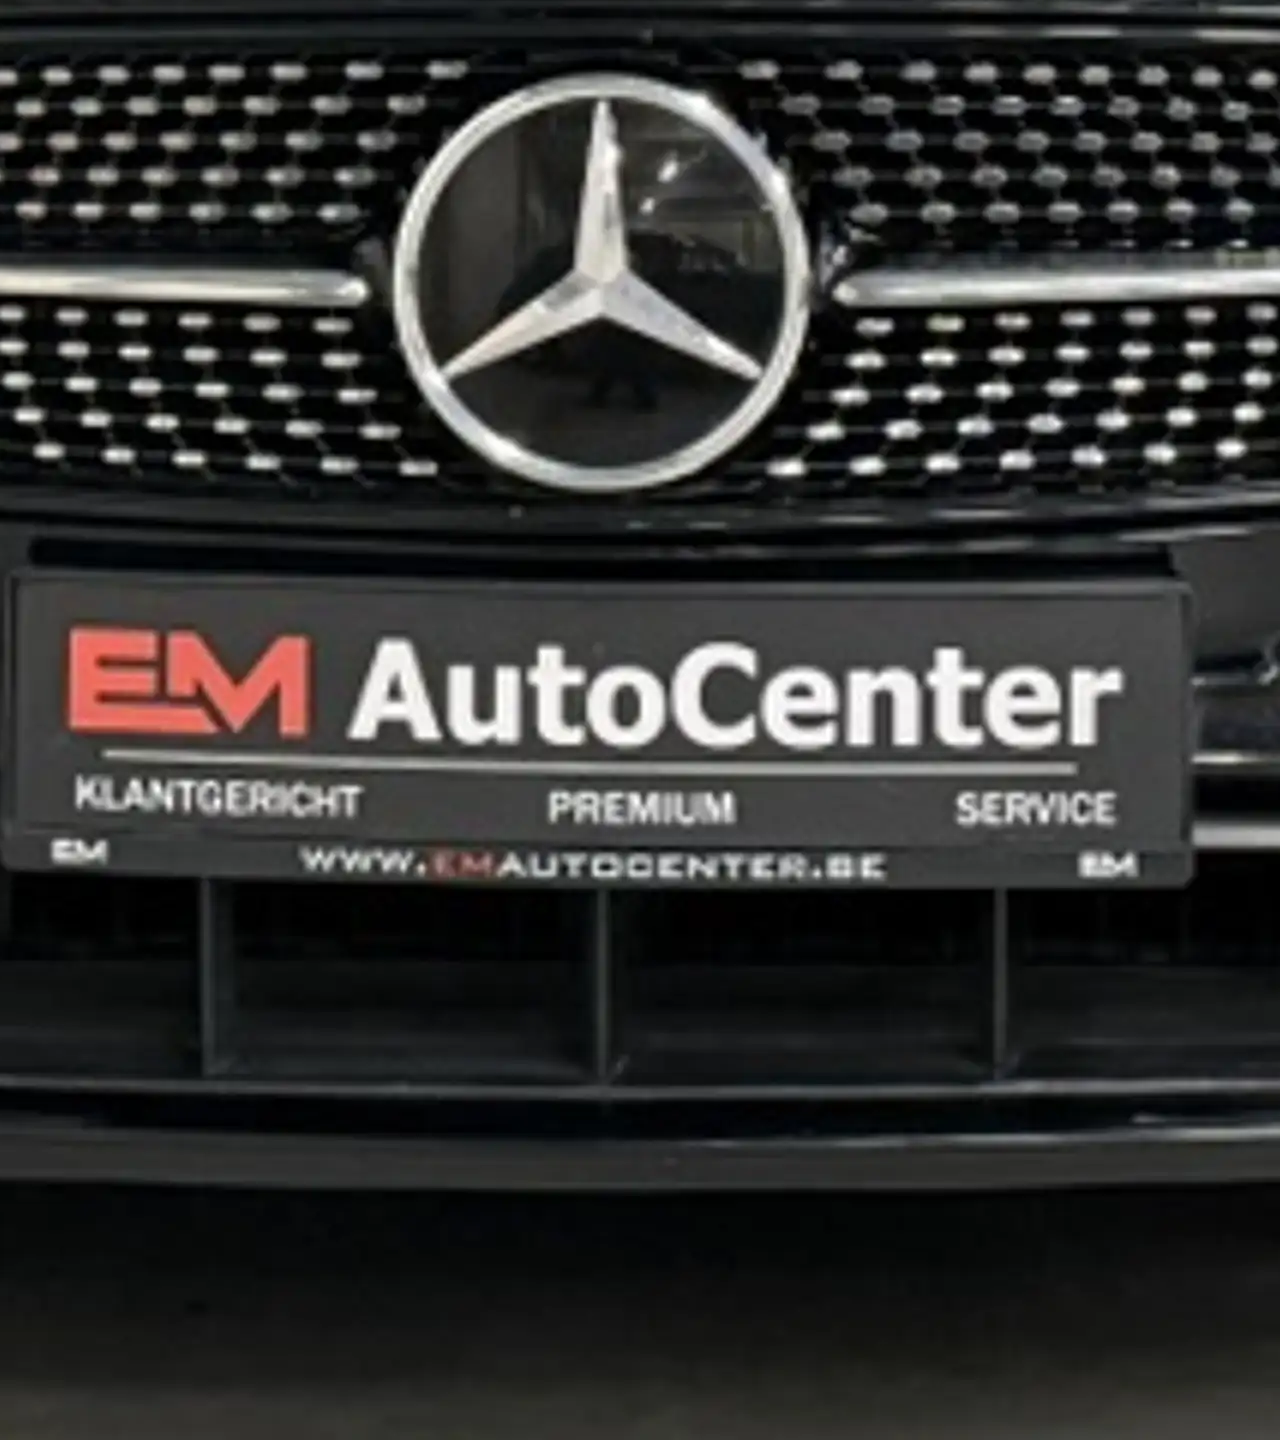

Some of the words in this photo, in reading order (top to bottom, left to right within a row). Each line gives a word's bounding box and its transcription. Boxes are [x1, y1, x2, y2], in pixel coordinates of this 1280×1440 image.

[67, 626, 311, 737] EM
[346, 637, 1123, 748] AutoCenter
[73, 774, 364, 819] KLANTGERICHT
[547, 790, 737, 826] PREMIUM
[955, 790, 1117, 827] SERVICE
